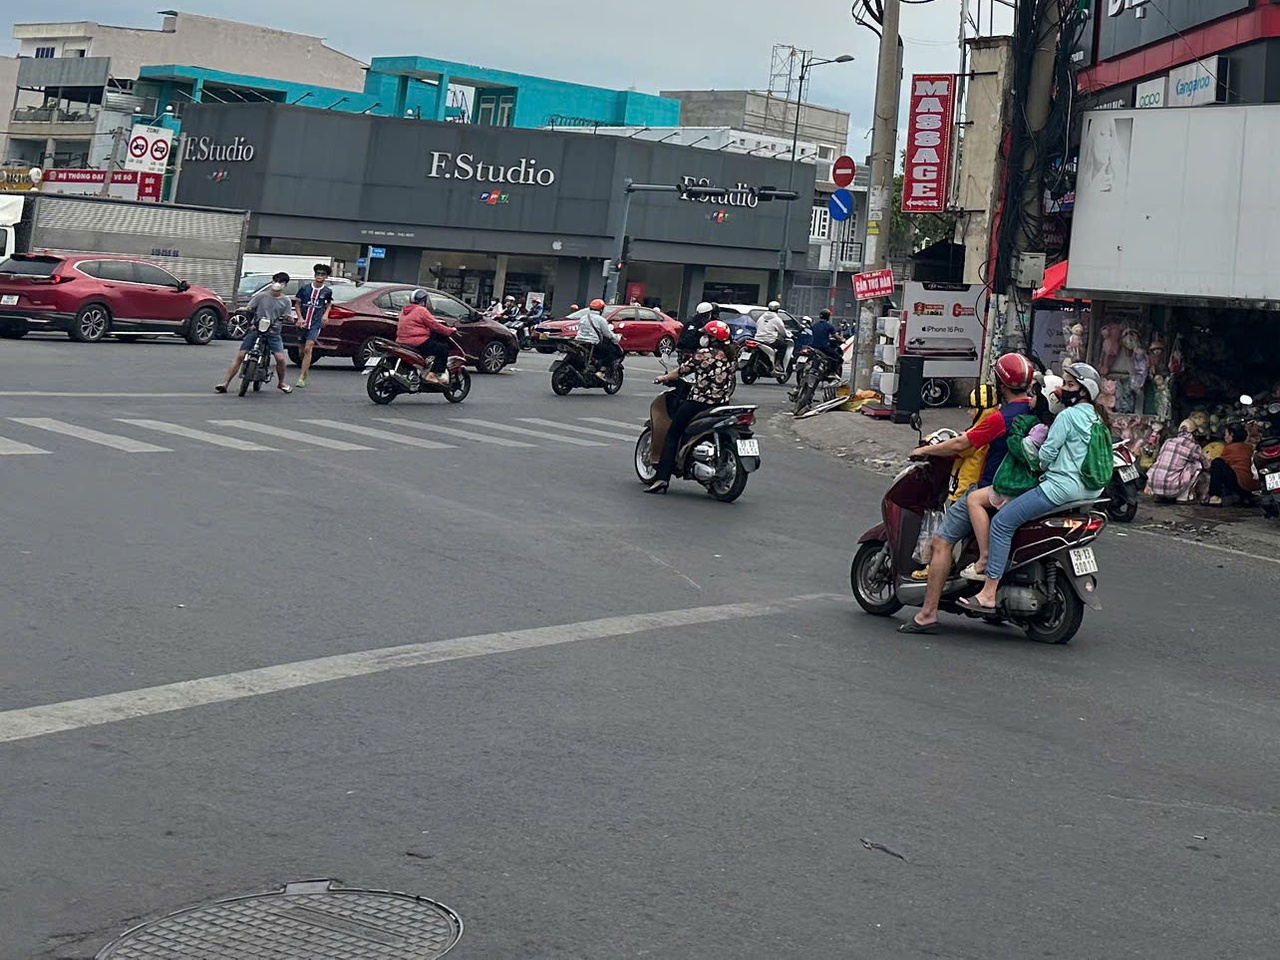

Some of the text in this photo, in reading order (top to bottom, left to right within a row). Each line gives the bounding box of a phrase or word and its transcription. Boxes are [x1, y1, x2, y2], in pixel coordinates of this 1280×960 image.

[1175, 75, 1211, 98] Kangaroo
[184, 136, 255, 161] F.Studio
[911, 81, 949, 197] MASSAGE
[427, 151, 556, 187] F.Studio
